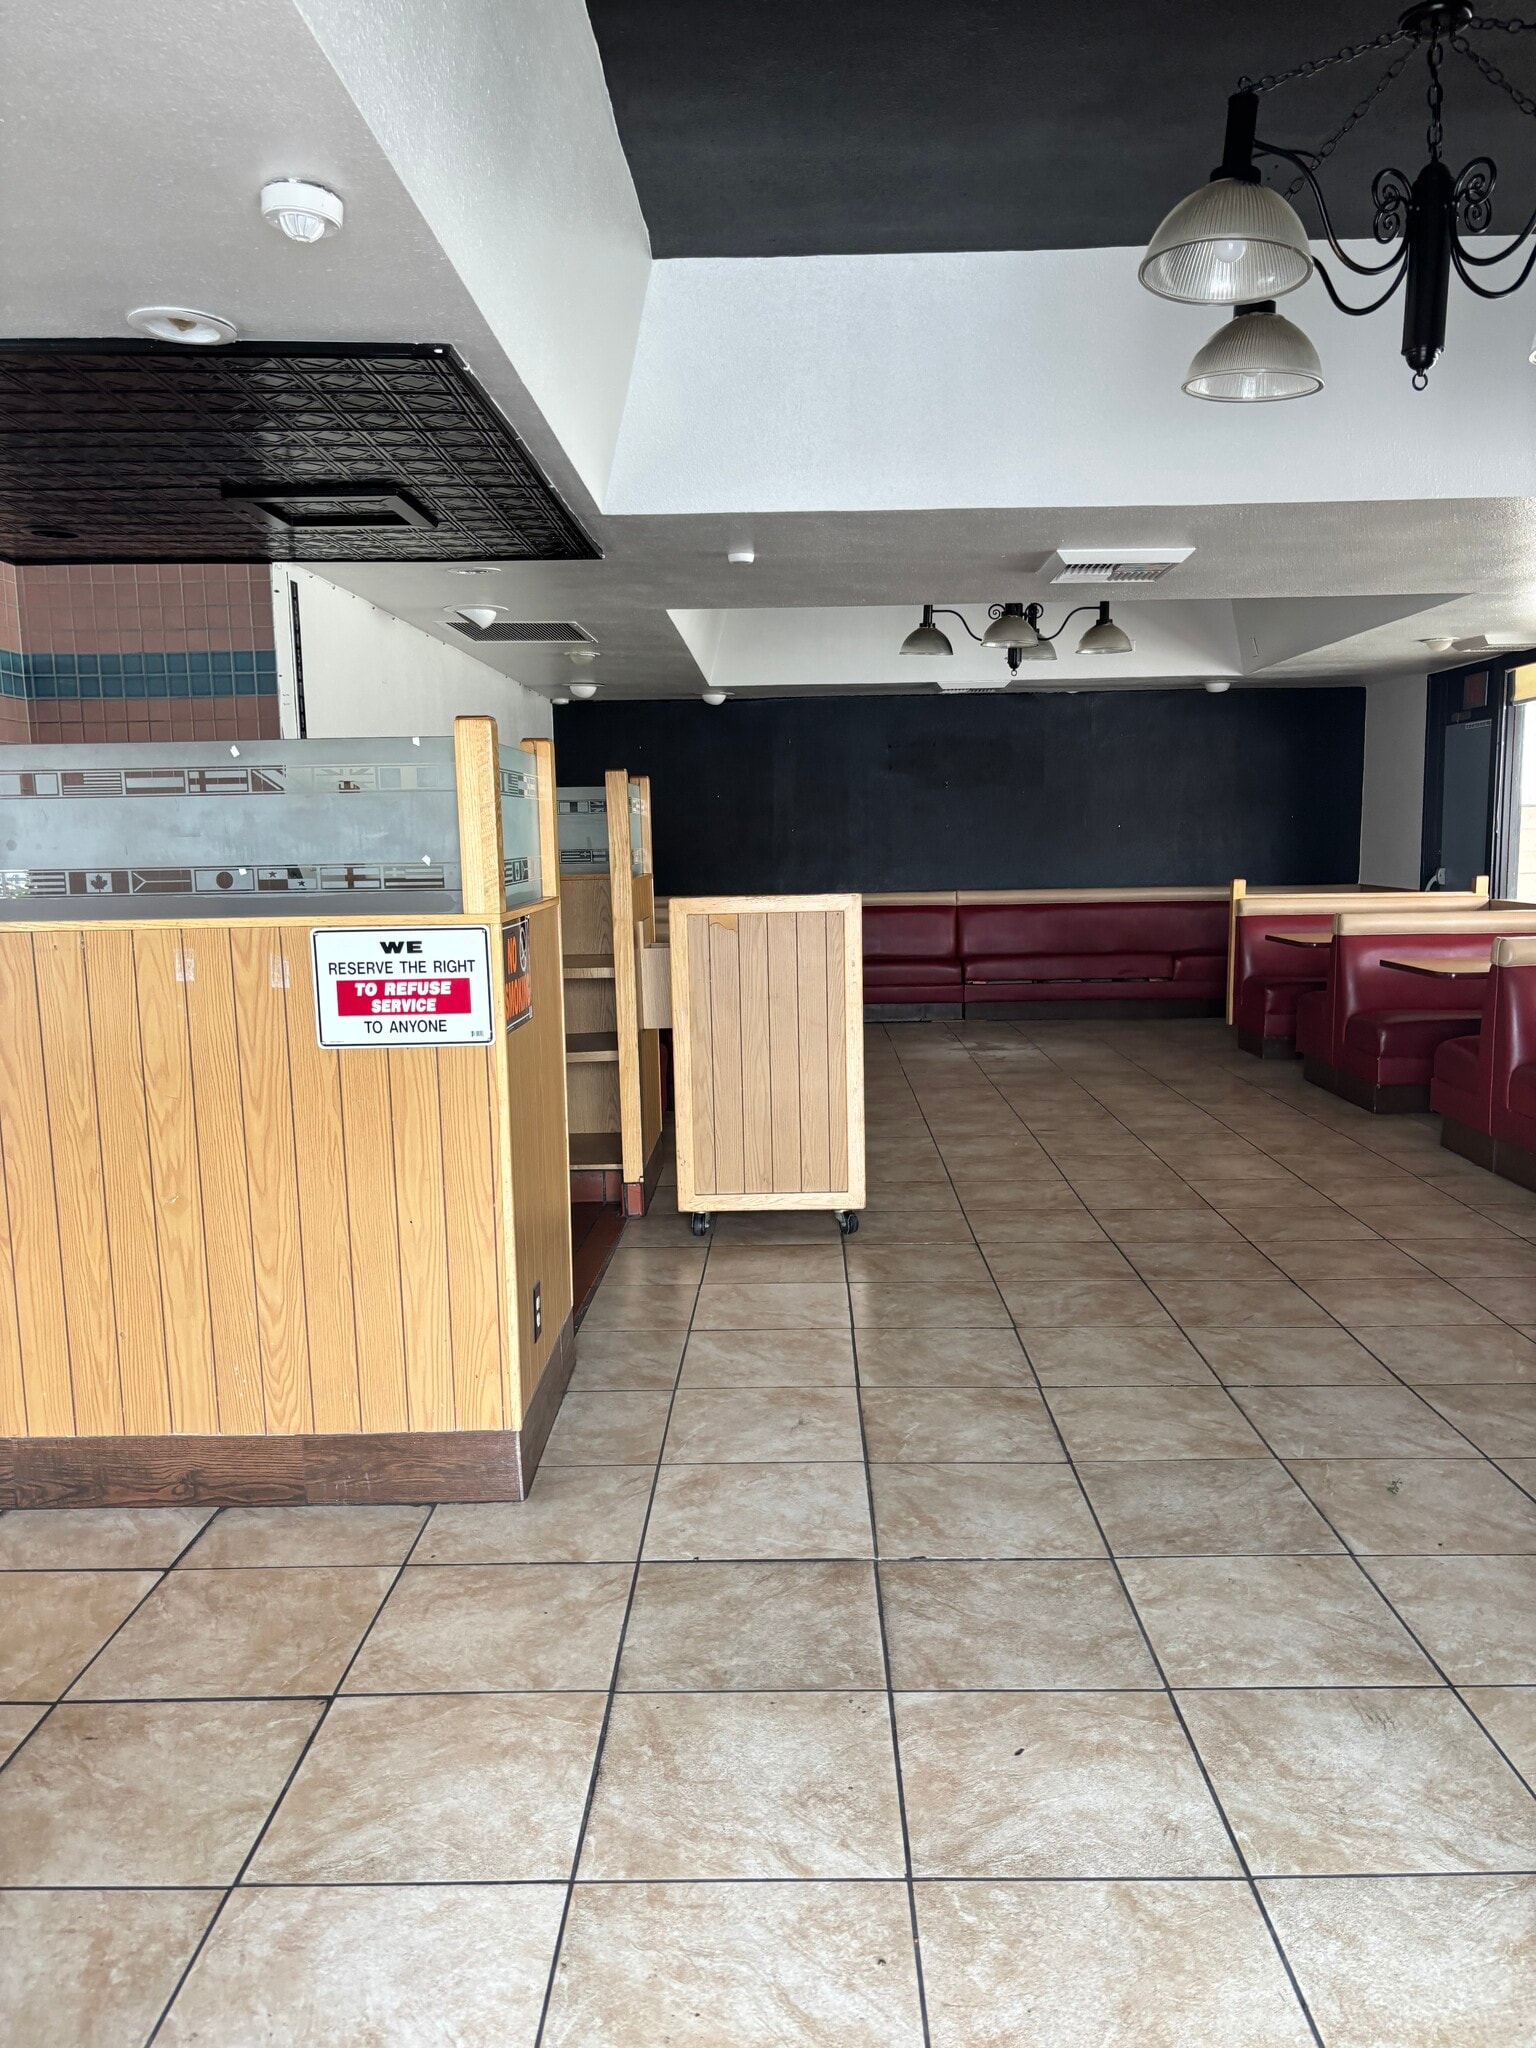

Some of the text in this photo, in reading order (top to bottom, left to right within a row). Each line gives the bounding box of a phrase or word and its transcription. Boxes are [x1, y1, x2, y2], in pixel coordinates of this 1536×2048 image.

[379, 941, 423, 954] WE
[507, 936, 517, 975] NO
[328, 959, 476, 976] RESERVE THE RIGHT
[354, 981, 452, 997] TO REFUSE
[505, 973, 531, 1021] SMOKING
[371, 998, 437, 1014] SERVICE
[364, 1019, 448, 1034] TO ANYONE
